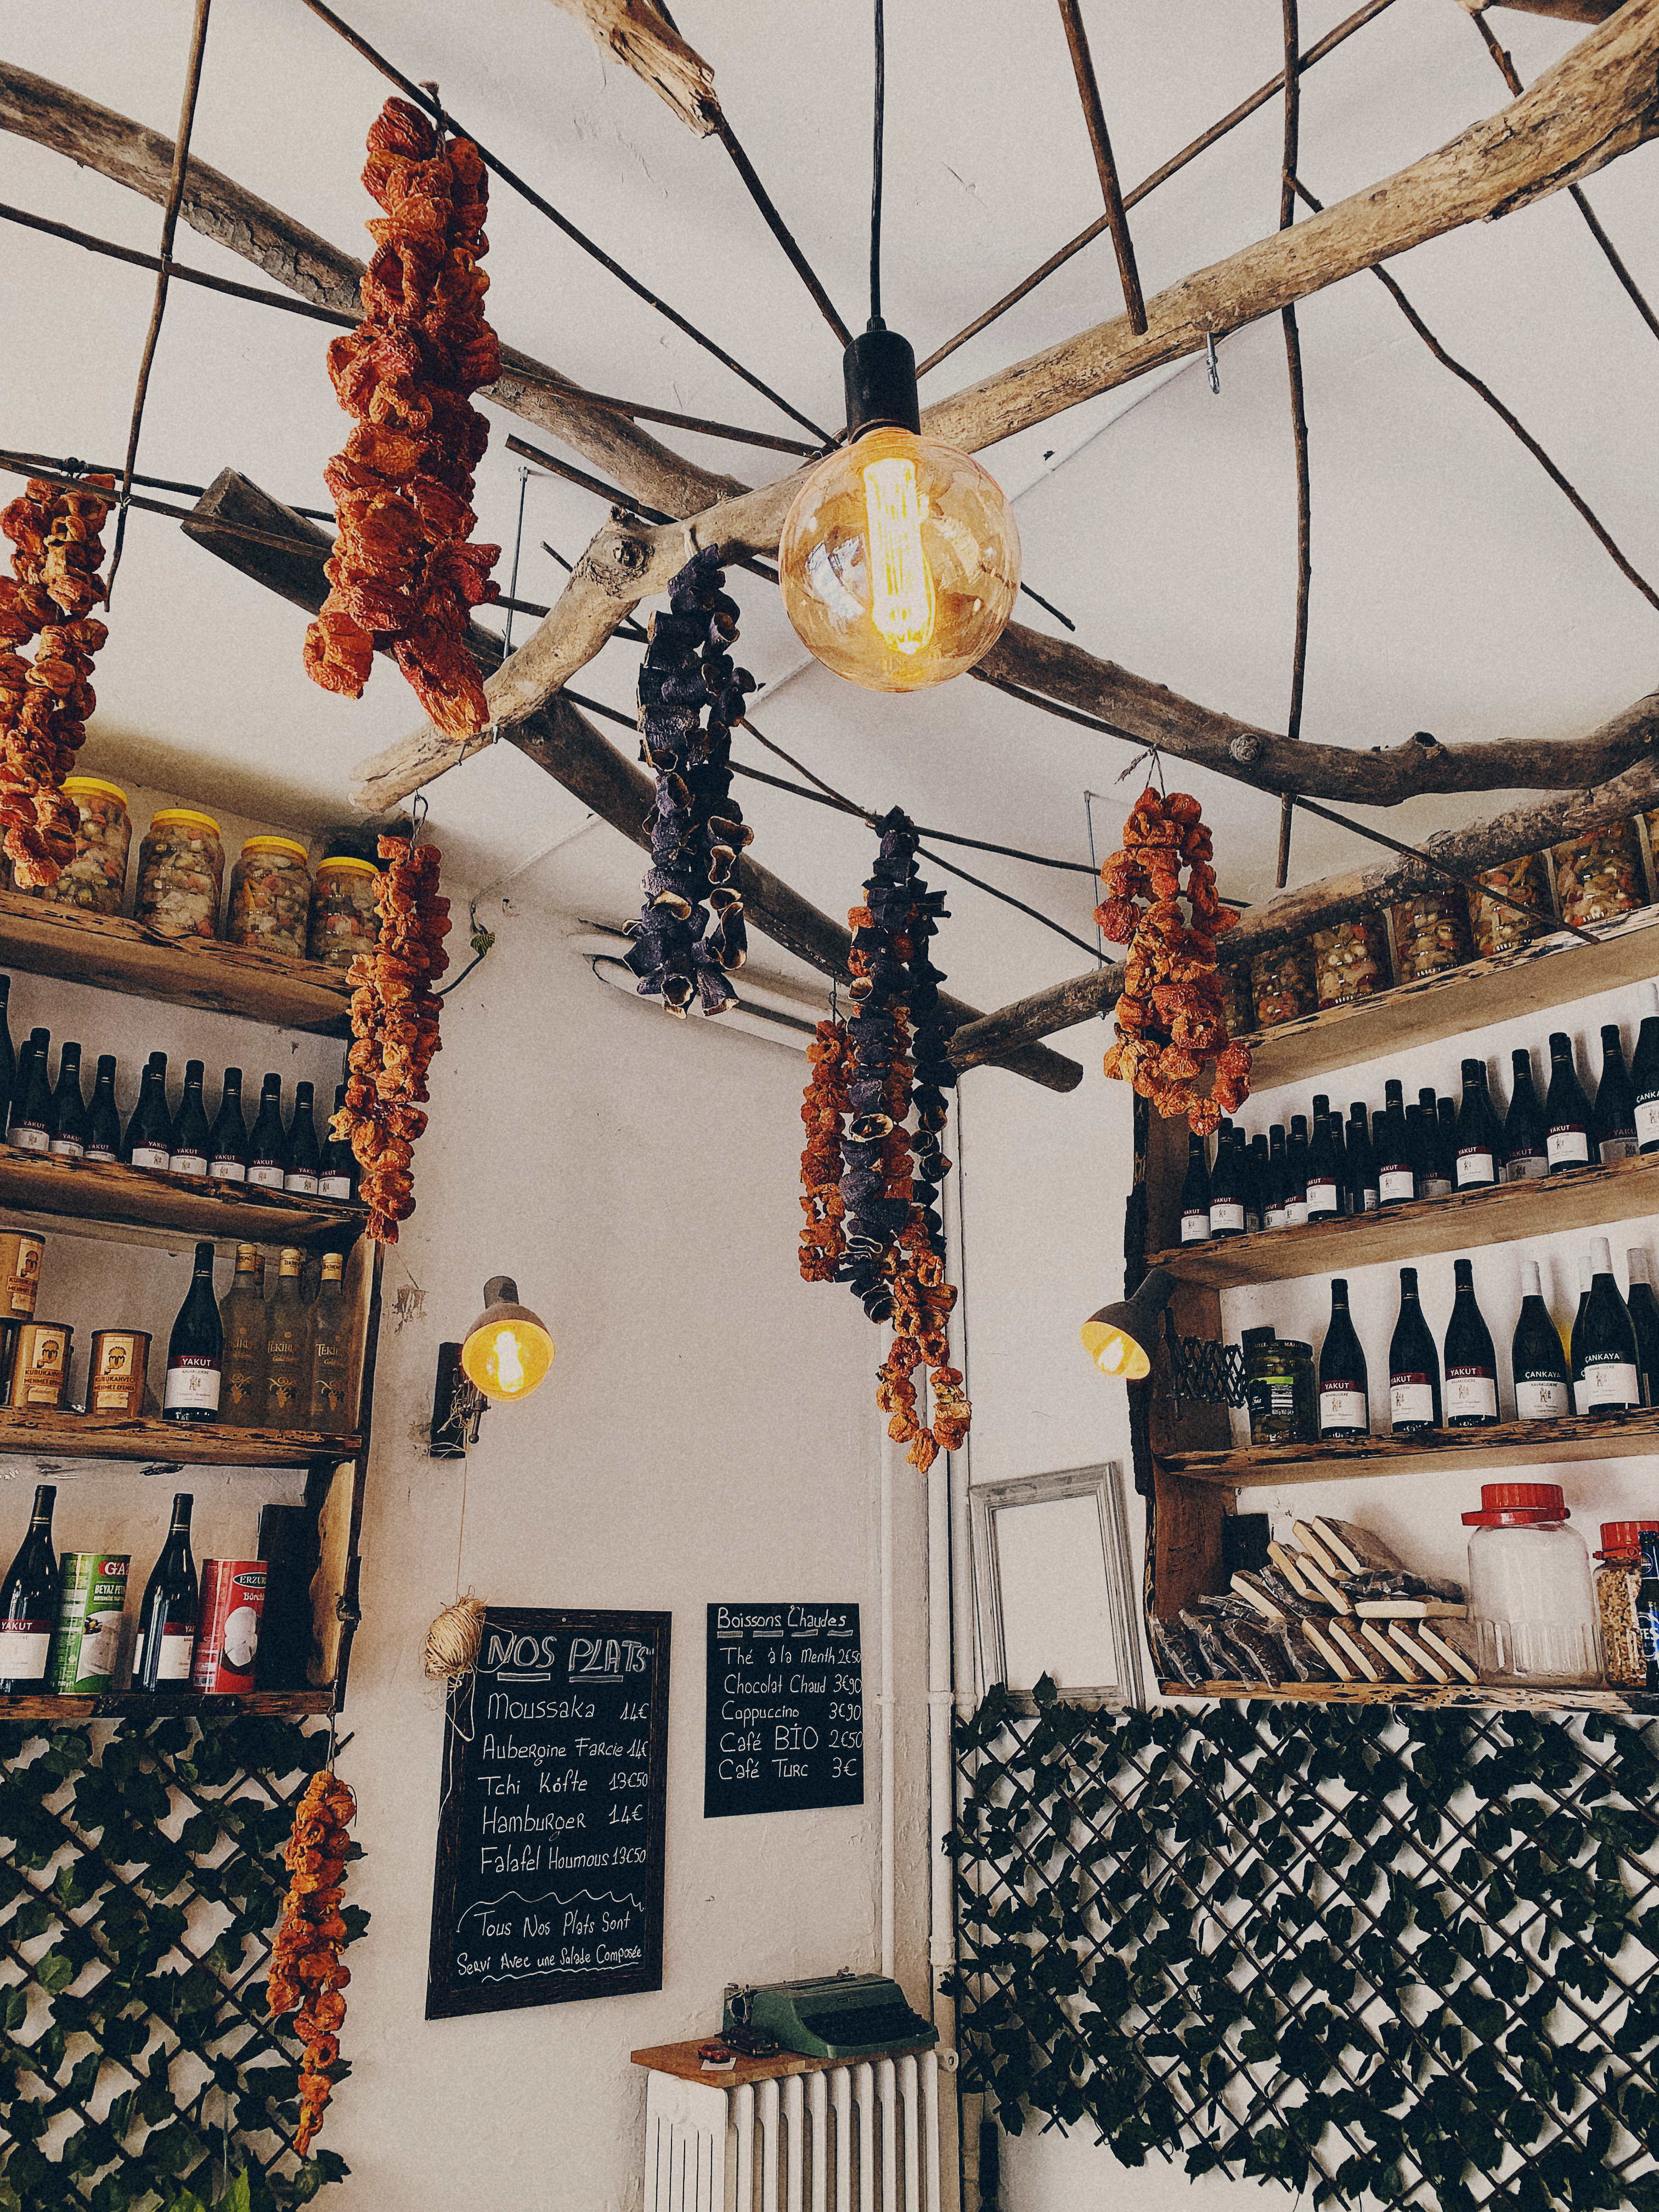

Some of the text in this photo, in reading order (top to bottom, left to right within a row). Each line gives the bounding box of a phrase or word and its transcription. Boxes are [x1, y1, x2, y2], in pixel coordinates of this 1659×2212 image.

[24, 1120, 45, 1129] YAKUT
[1550, 1125, 1570, 1133] YAKUT
[1613, 1128, 1637, 1136] YAKU
[63, 1133, 82, 1142] YAKUT
[1458, 1147, 1477, 1155] YAKUT
[182, 1358, 211, 1367] YAKUT
[1585, 1353, 1620, 1363] ÇANKAYA
[1391, 1375, 1412, 1384] YAKUT
[1450, 1368, 1476, 1376] YAKUT
[94, 1584, 115, 1594] BEYAZ
[2, 1622, 32, 1630] YAKUT
[717, 1605, 847, 1629] Boissons Chaudes
[488, 1635, 650, 1672] NOS PLATS
[720, 1647, 754, 1664] Thé
[768, 1647, 776, 1663] à
[781, 1645, 792, 1663] la
[838, 1650, 862, 1664] 2€50
[724, 1673, 862, 1695] Chocolat Chaud 3€90
[488, 1693, 650, 1721] Moussaka 14€
[722, 1701, 861, 1728] Cappuccino 3€90
[627, 1739, 648, 1759] 14€
[720, 1732, 761, 1752] Café
[829, 1730, 864, 1747] 2€50
[719, 1758, 760, 1780] Café
[832, 1757, 857, 1778] 3€
[478, 1774, 520, 1795] Tchi
[608, 1772, 648, 1790] 13€50
[608, 1804, 644, 1825] 14€
[482, 1844, 647, 1874] Falafel Houmous 13€50
[474, 1909, 630, 1937] Tous Nos Plats Sont
[501, 1953, 531, 1969] Avec
[537, 1955, 555, 1967] une
[560, 1946, 591, 1965] Salade
[596, 1944, 642, 1964] Composée
